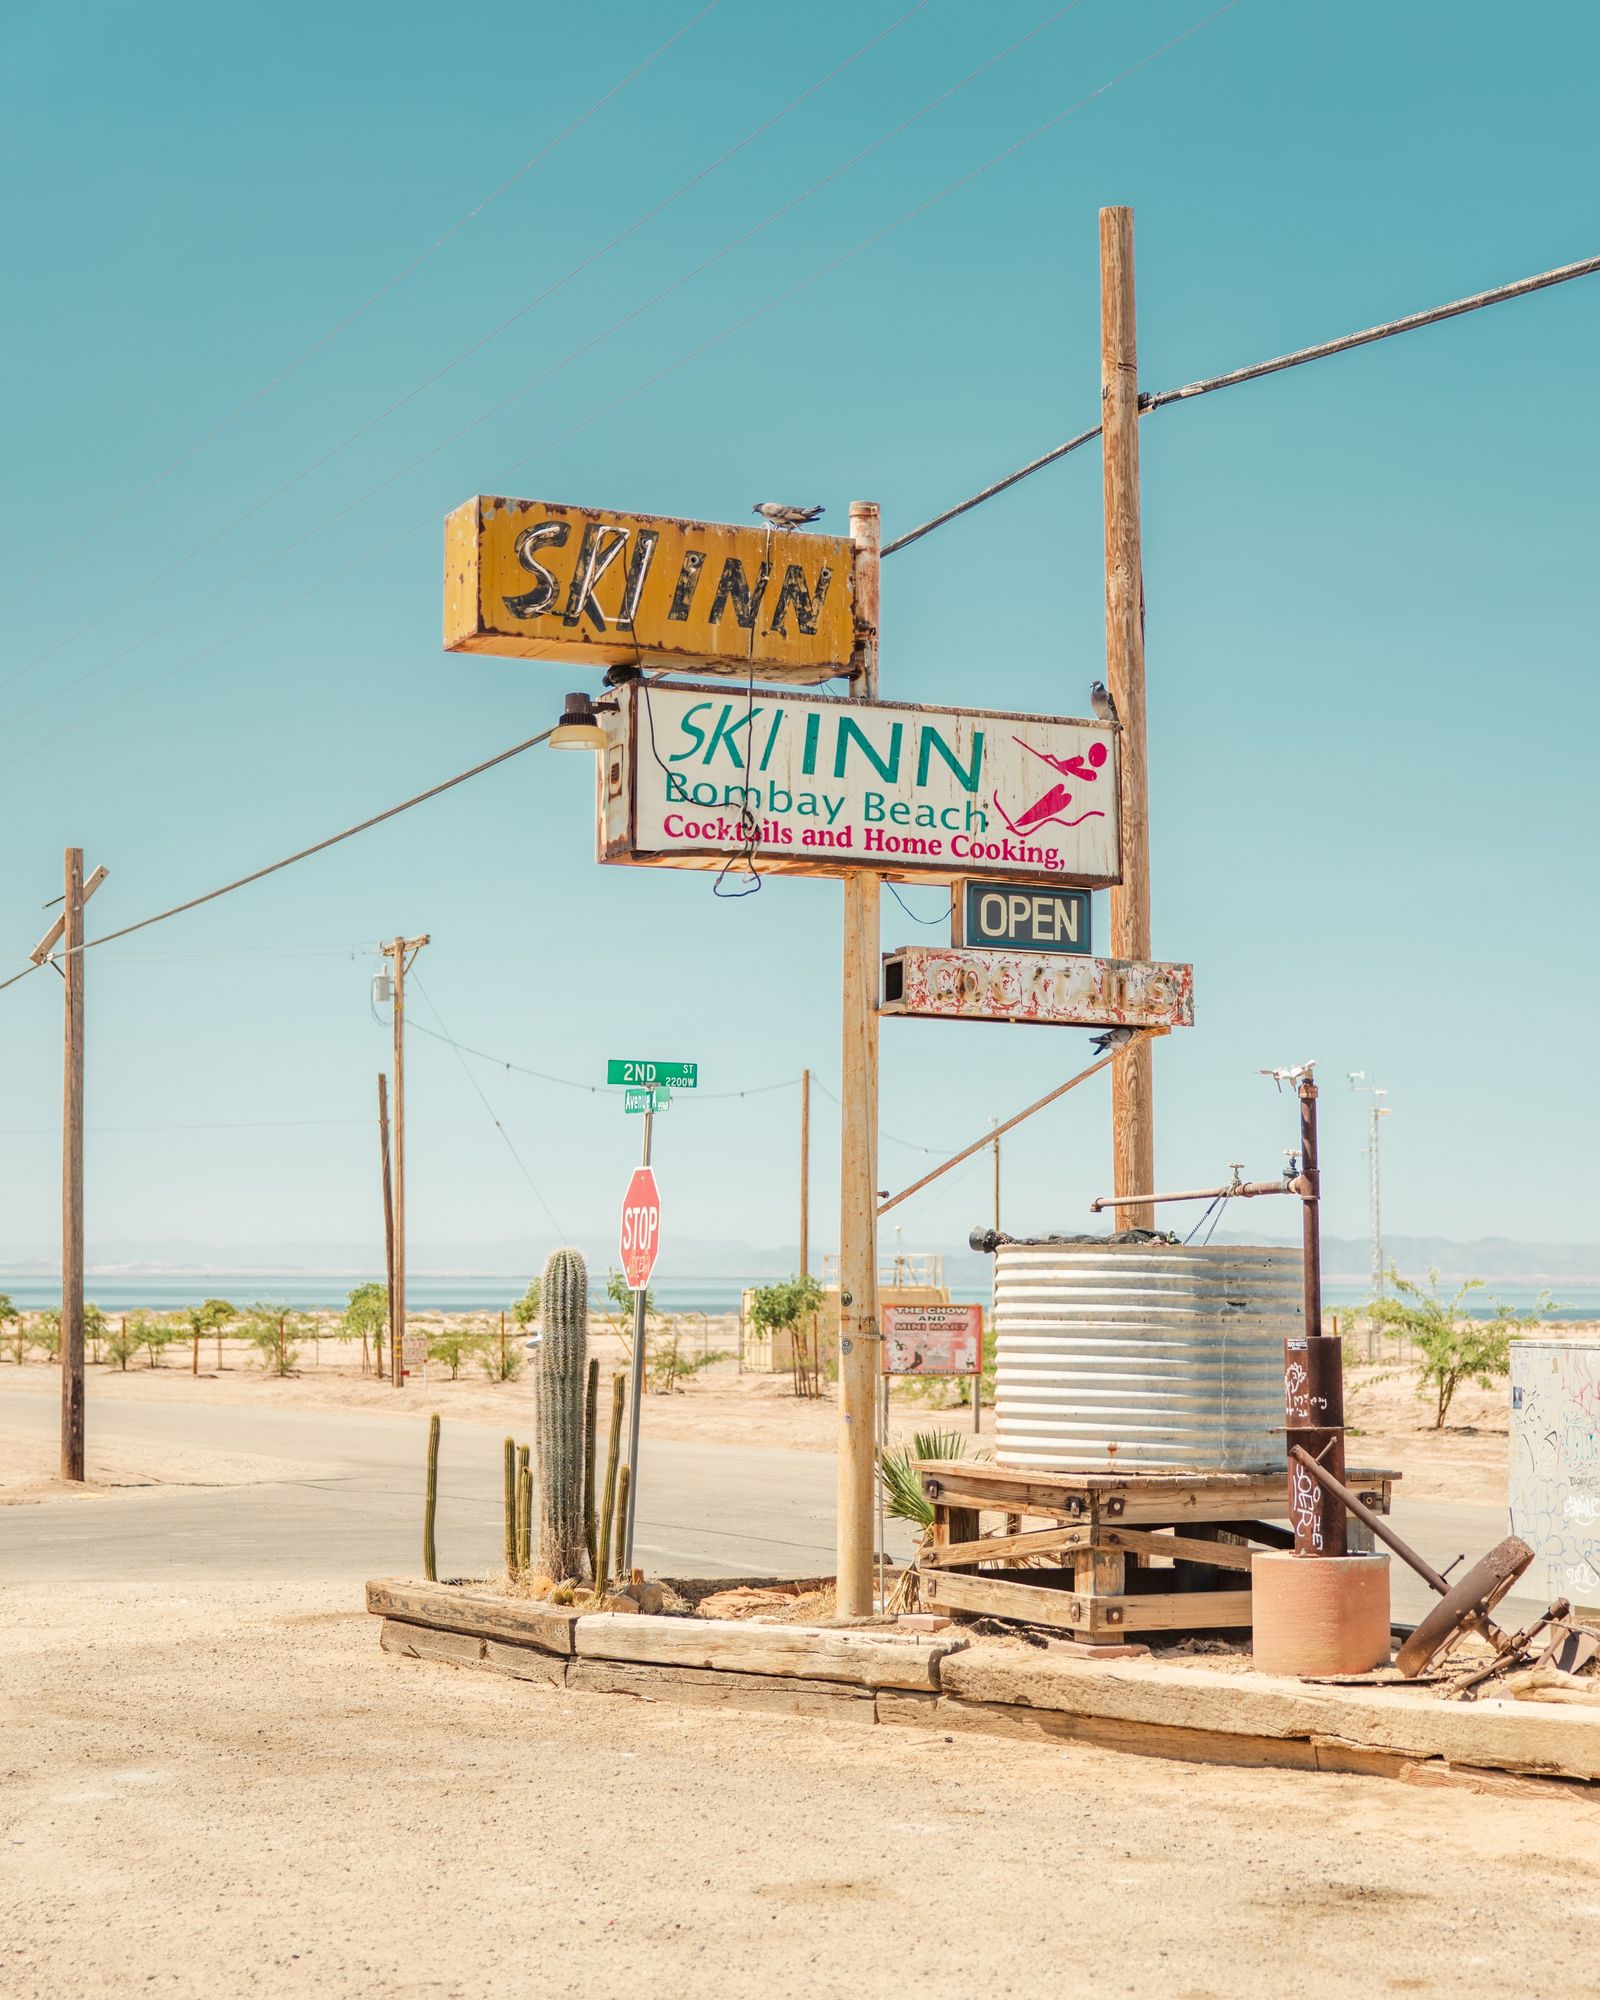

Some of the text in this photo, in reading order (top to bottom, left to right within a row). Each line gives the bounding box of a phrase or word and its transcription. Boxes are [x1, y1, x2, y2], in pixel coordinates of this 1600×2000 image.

[502, 520, 833, 635] SKI INN
[669, 702, 983, 793] SKI INN
[666, 773, 987, 832] Bombay Beach
[802, 825, 852, 848] and
[865, 830, 943, 855] Home
[957, 837, 1066, 870] Cooking,
[980, 894, 1077, 942] OPEN
[623, 1063, 694, 1082] 2ND ST
[666, 1077, 694, 1087] 2200W
[623, 1206, 657, 1250] STOP
[895, 1323, 968, 1331] MINI MART
[896, 1307, 968, 1315] THE CHOW
